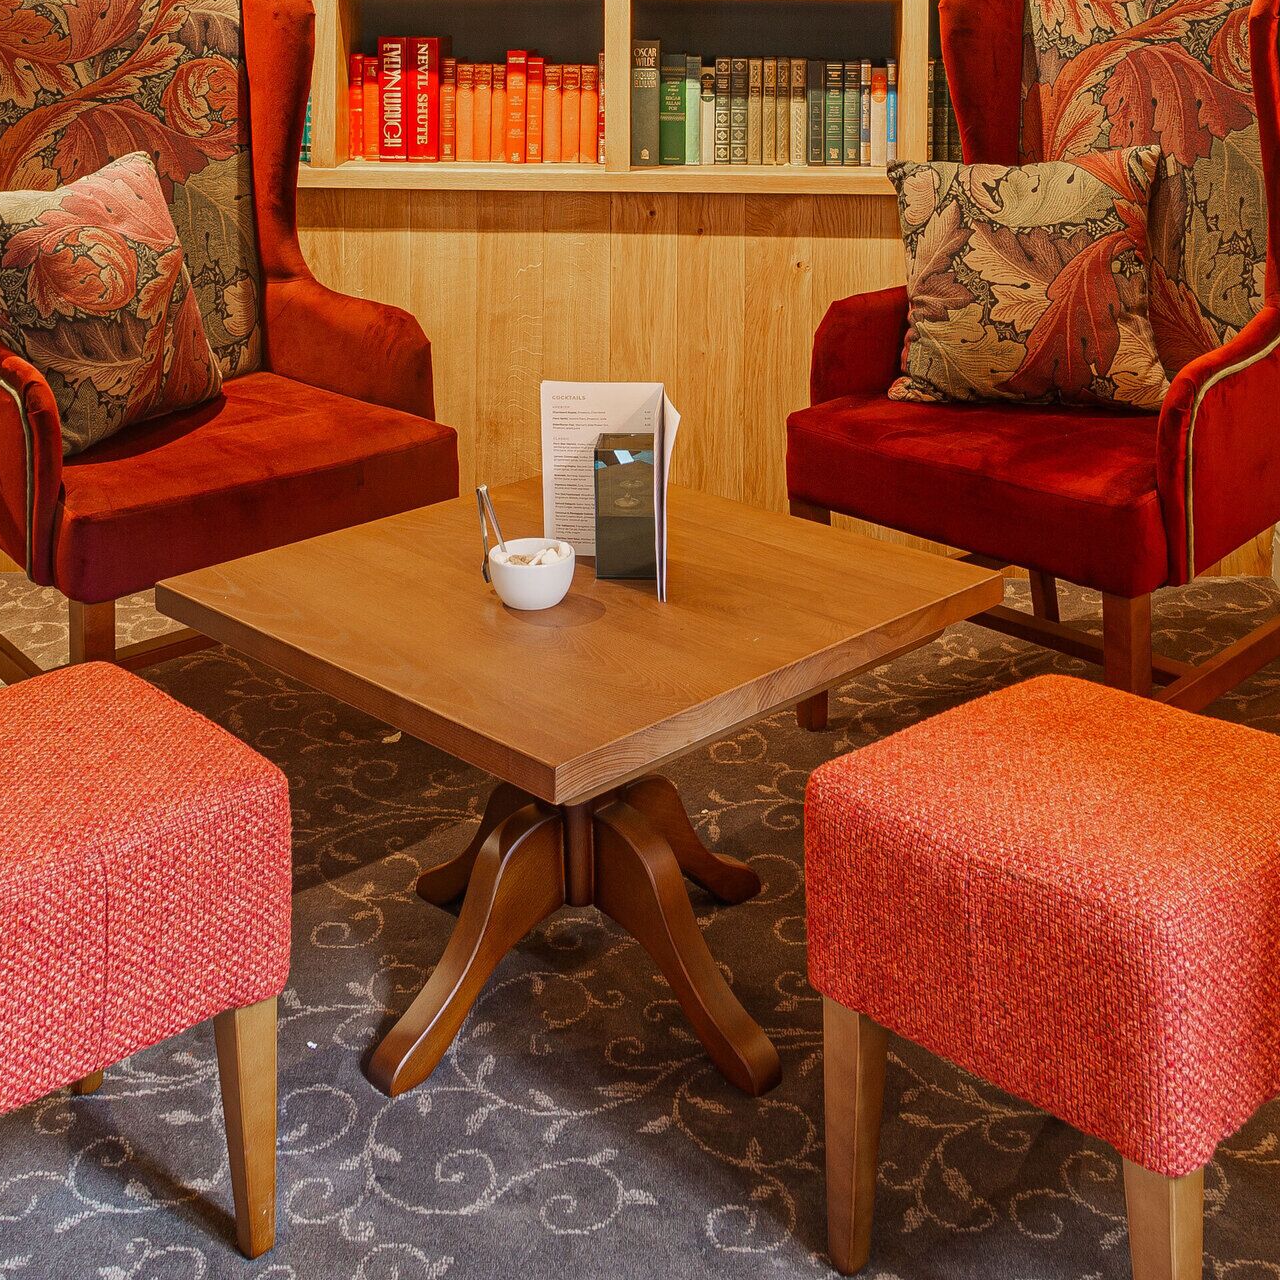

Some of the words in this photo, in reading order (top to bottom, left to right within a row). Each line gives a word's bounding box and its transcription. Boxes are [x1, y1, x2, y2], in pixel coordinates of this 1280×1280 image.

[382, 43, 402, 91] EVELYN
[417, 43, 429, 90] NEVIL
[633, 47, 657, 57] OSCAR
[635, 57, 656, 67] WILDE
[383, 92, 403, 148] WAUGH
[416, 93, 428, 145] SHUTE
